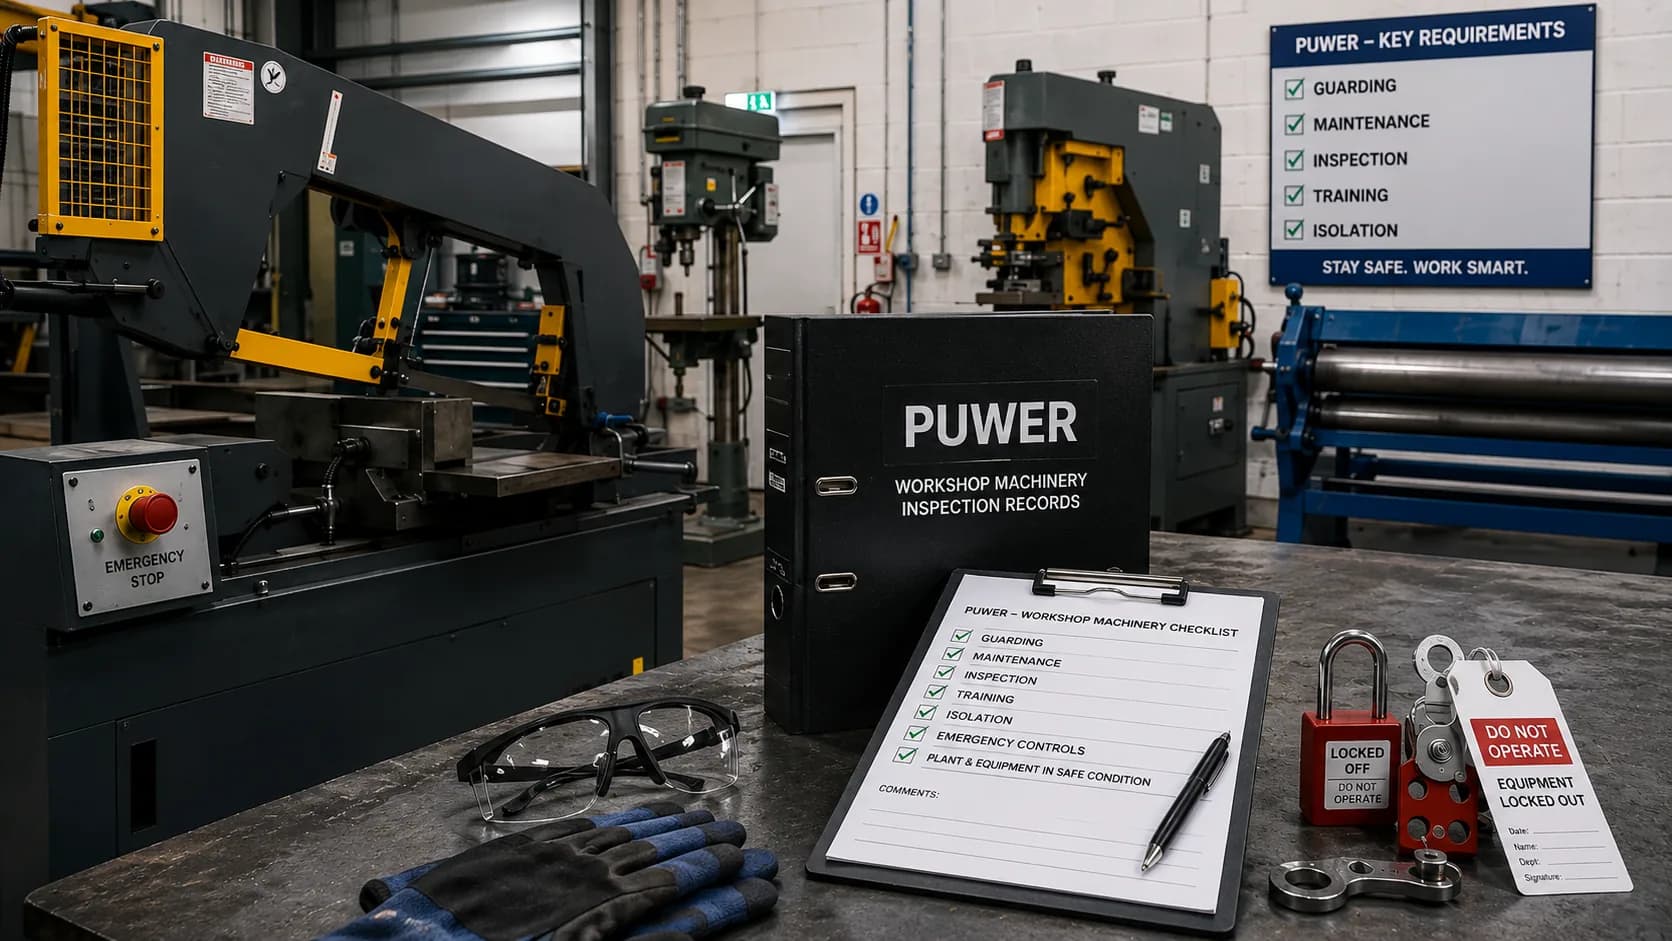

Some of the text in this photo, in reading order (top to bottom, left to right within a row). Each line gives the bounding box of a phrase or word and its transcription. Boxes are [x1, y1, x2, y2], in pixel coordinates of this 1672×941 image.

[1295, 35, 1359, 54] PUWER
[1379, 30, 1415, 49] KEY
[1419, 21, 1566, 47] REQUIREMENTS
[1313, 78, 1397, 96] GUARDING
[1313, 113, 1431, 132] MAINTENANCE
[1313, 151, 1408, 168] INSPECTION
[1313, 188, 1389, 204] TRAINING
[1313, 223, 1399, 238] ISOLATION
[1322, 260, 1528, 276] STAY SAFE. WORK SMART.
[905, 400, 1078, 449] PUWER
[895, 473, 1088, 495] WORKSHOP MACHINERY
[901, 494, 1080, 517] INSPECTION RECORDS
[105, 549, 185, 574] EMERGENCY
[130, 571, 165, 588] STOP
[964, 606, 1008, 618] PUWER
[1021, 610, 1092, 625] WORKSHOP
[1093, 617, 1168, 631] MACHINERY
[1169, 622, 1240, 638] CHECKLIST
[981, 633, 1044, 648] GUARDING
[972, 651, 1062, 668] MAINTENANCE
[963, 670, 1038, 686] INSPECTION
[956, 690, 1015, 705] TRAINING
[946, 710, 1014, 726] ISOLATION
[1485, 724, 1548, 739] DO NOT
[936, 731, 1086, 757] EMERGENCY CONTROLS
[1488, 743, 1563, 758] OPERATE
[1331, 747, 1385, 759] LOCKED
[926, 752, 1152, 787] PLANT & EQUIPMENT IN SAFE CONDITION
[1345, 763, 1370, 774] OFF
[878, 783, 940, 800] COMMENTS:
[1338, 782, 1377, 792] DO NOT
[1497, 777, 1574, 790] EQUIPMENT
[1334, 794, 1382, 804] OPERATE
[1499, 795, 1585, 808] LOCKED OUT
[1508, 826, 1529, 835] Date:
[1524, 872, 1562, 883] Signature:
